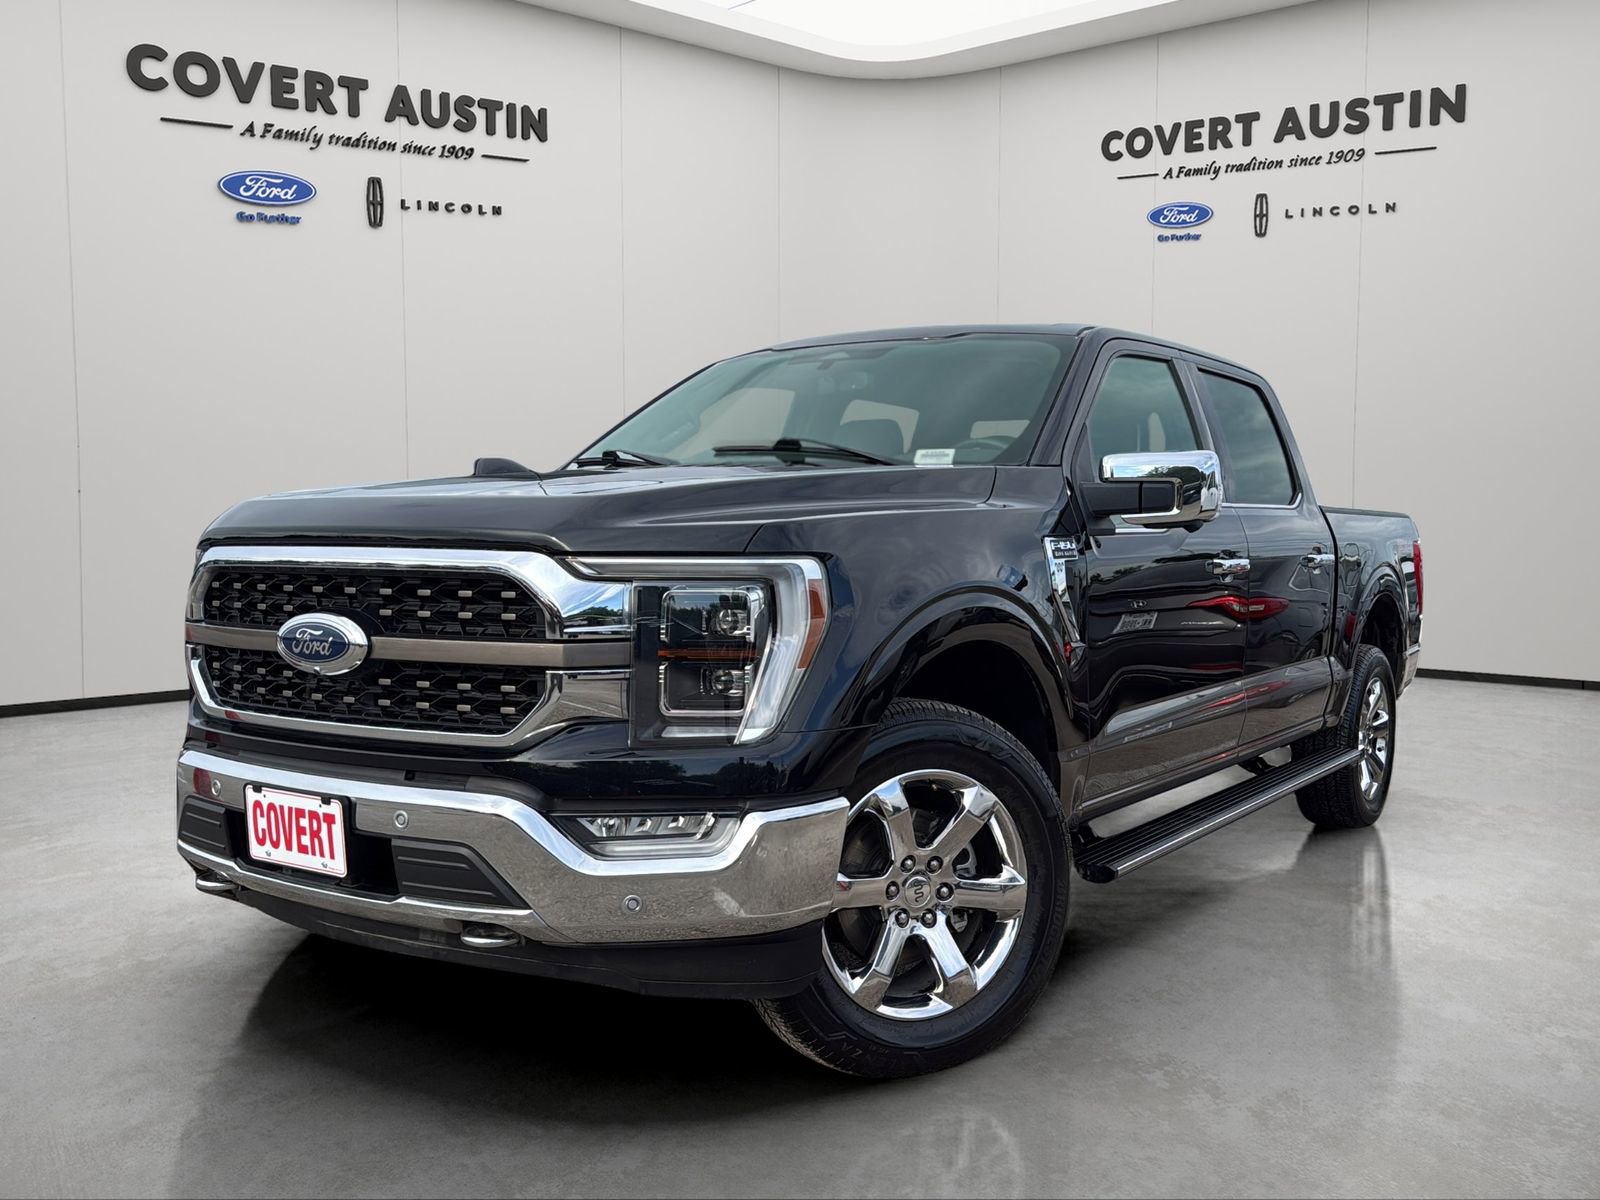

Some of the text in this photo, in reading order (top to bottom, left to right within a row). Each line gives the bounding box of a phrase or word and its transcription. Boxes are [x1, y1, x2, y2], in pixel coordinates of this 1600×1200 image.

[126, 43, 549, 142] COVERT AUSTIN
[1100, 83, 1467, 161] COVERT AUSTIN
[240, 121, 475, 160] A Family tradition since 1909
[1163, 147, 1366, 181] A Family tradition since 1909
[239, 175, 298, 200] Ford
[236, 211, 256, 224] Go
[400, 198, 503, 217] LINCOLN
[1160, 206, 1200, 224] Ford
[1284, 202, 1397, 219] LINCOLN
[1157, 233, 1170, 243] Go
[292, 627, 333, 657] Ford
[252, 799, 336, 861] COVERT
